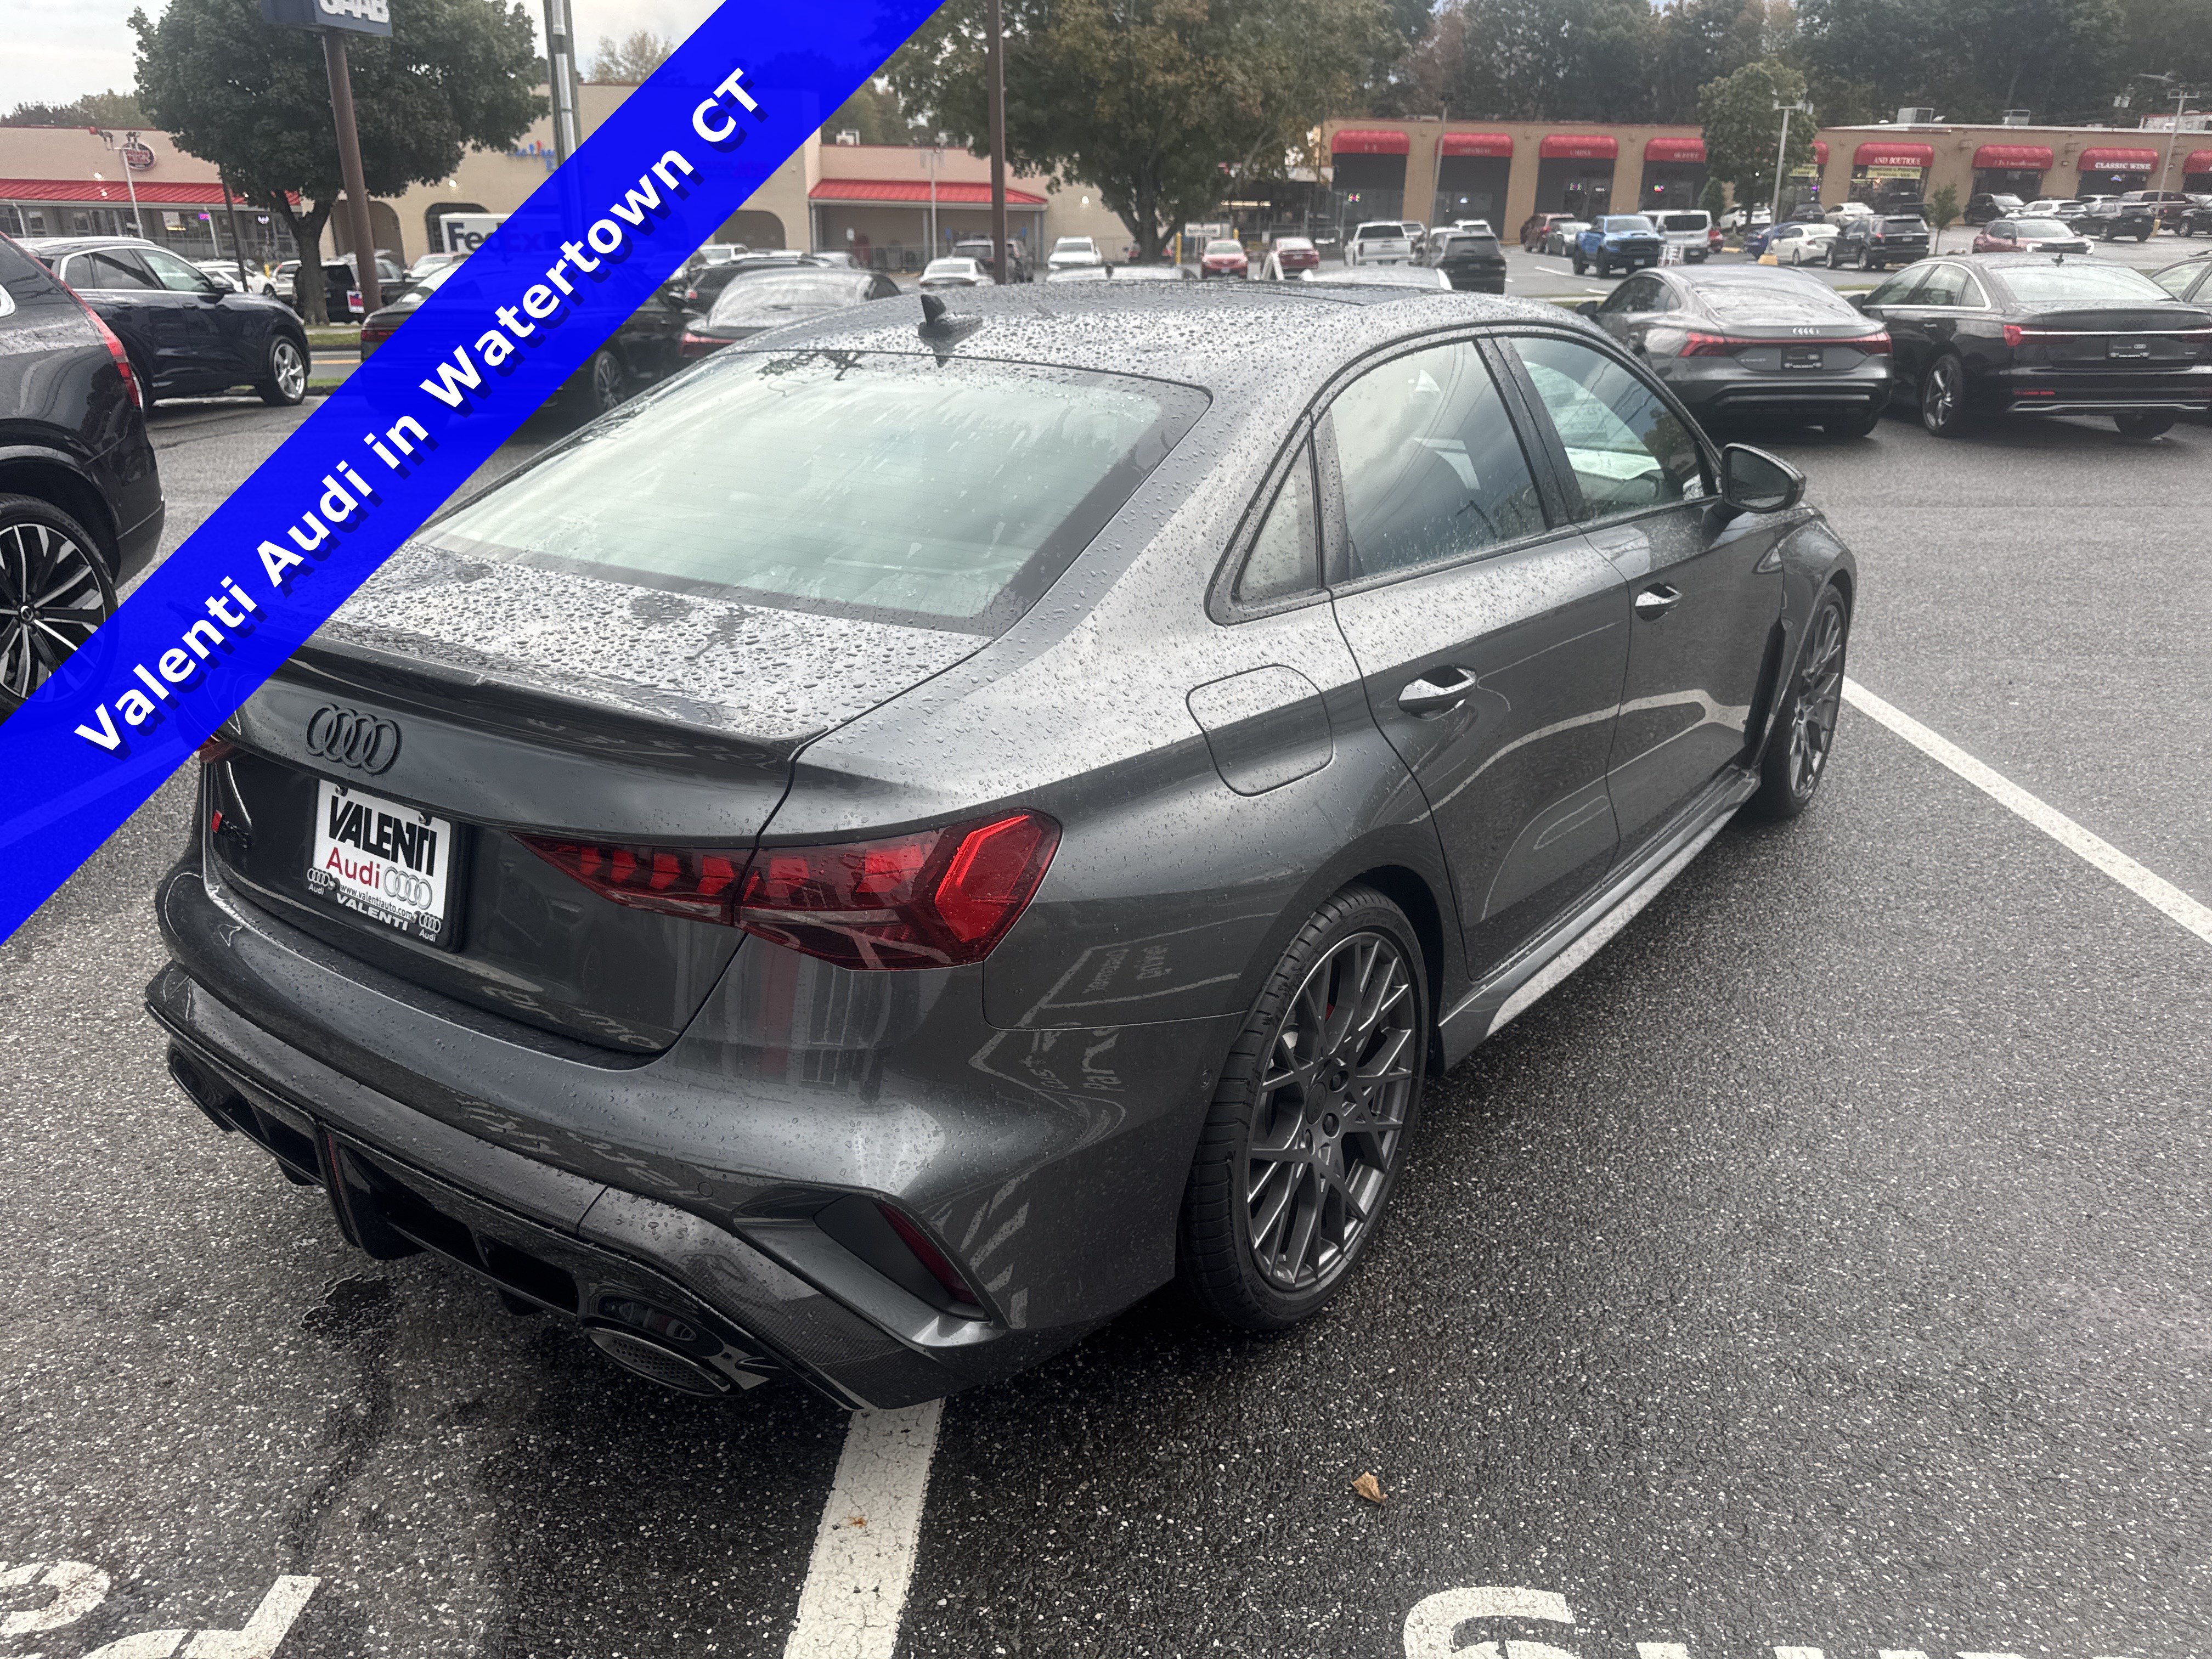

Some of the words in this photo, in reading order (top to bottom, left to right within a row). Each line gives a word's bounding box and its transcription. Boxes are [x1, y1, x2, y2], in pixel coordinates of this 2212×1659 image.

[329, 795, 437, 877] VALENTI
[326, 847, 380, 889] Audi
[308, 883, 324, 895] Audi
[340, 884, 413, 919] www.valentiauto.com
[336, 893, 409, 931] VALENTI
[419, 929, 436, 943] Audi
